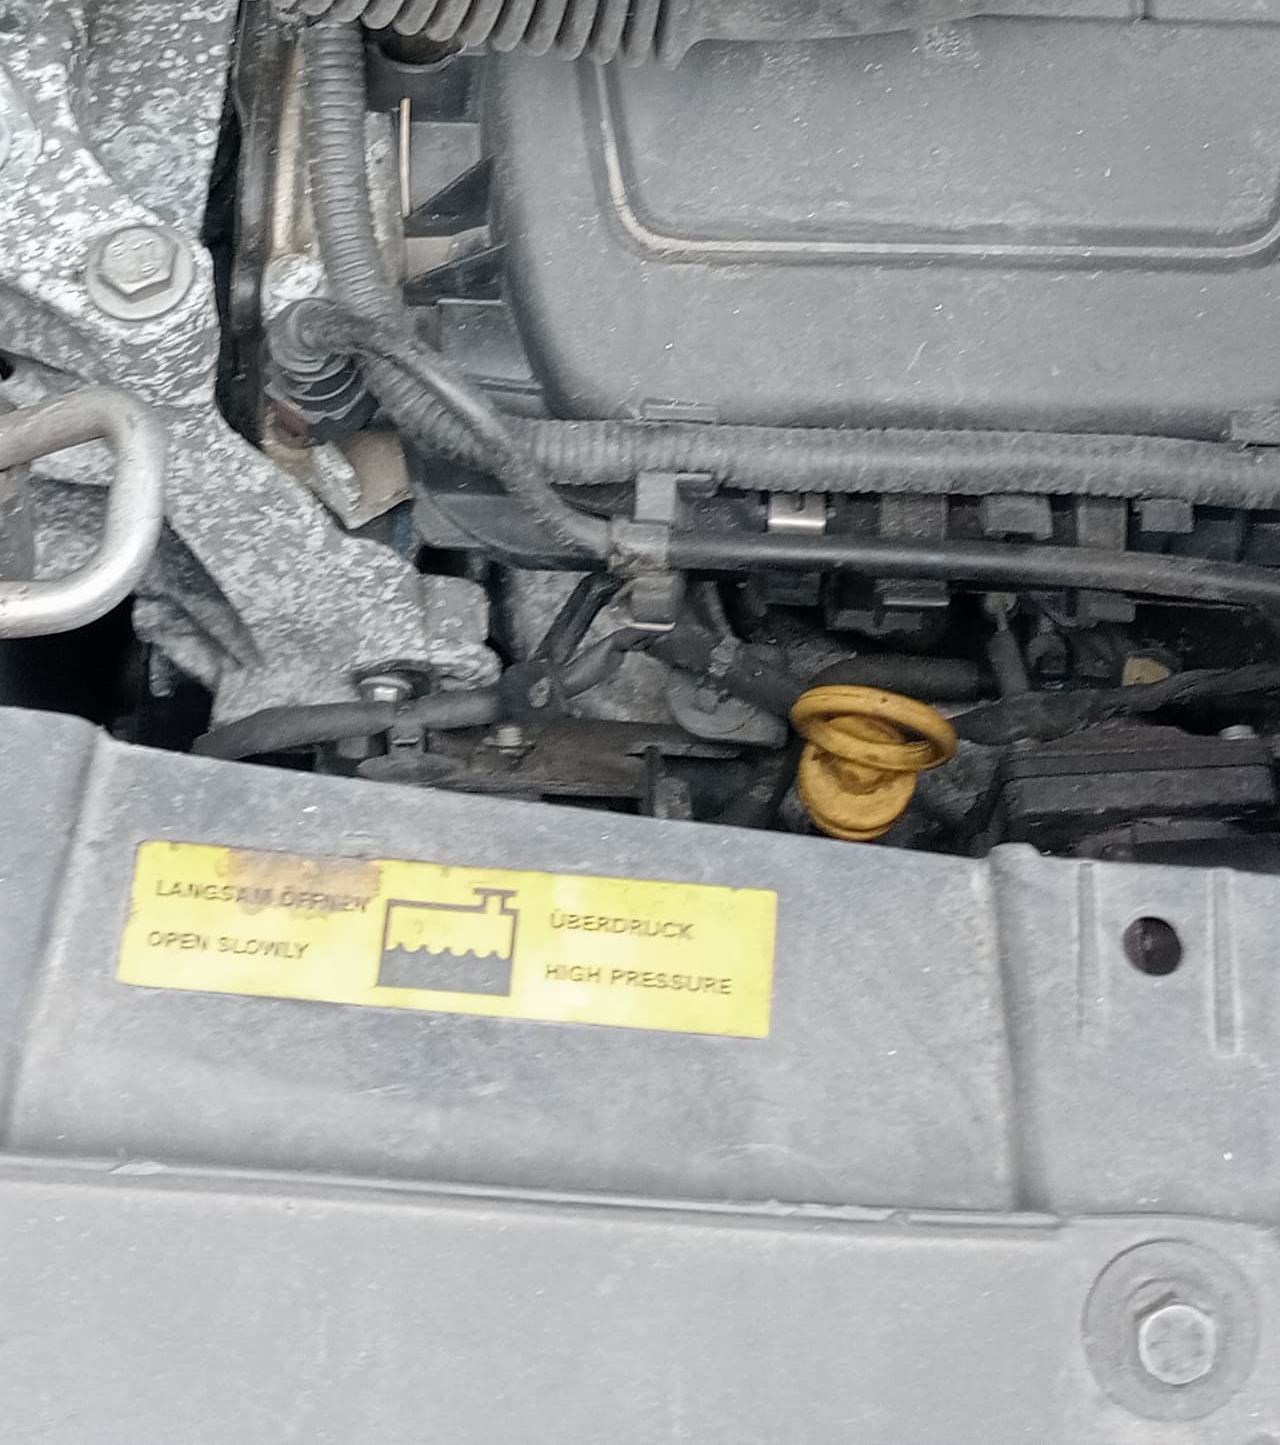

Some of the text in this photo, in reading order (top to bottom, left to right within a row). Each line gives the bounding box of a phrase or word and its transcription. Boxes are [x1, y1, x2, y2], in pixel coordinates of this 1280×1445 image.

[155, 880, 274, 904] LANGSAM
[549, 908, 695, 940] ÜBERDRUCK
[147, 930, 310, 960] OPEN SLOWLY
[545, 963, 733, 995] HIGH PRESSURE
